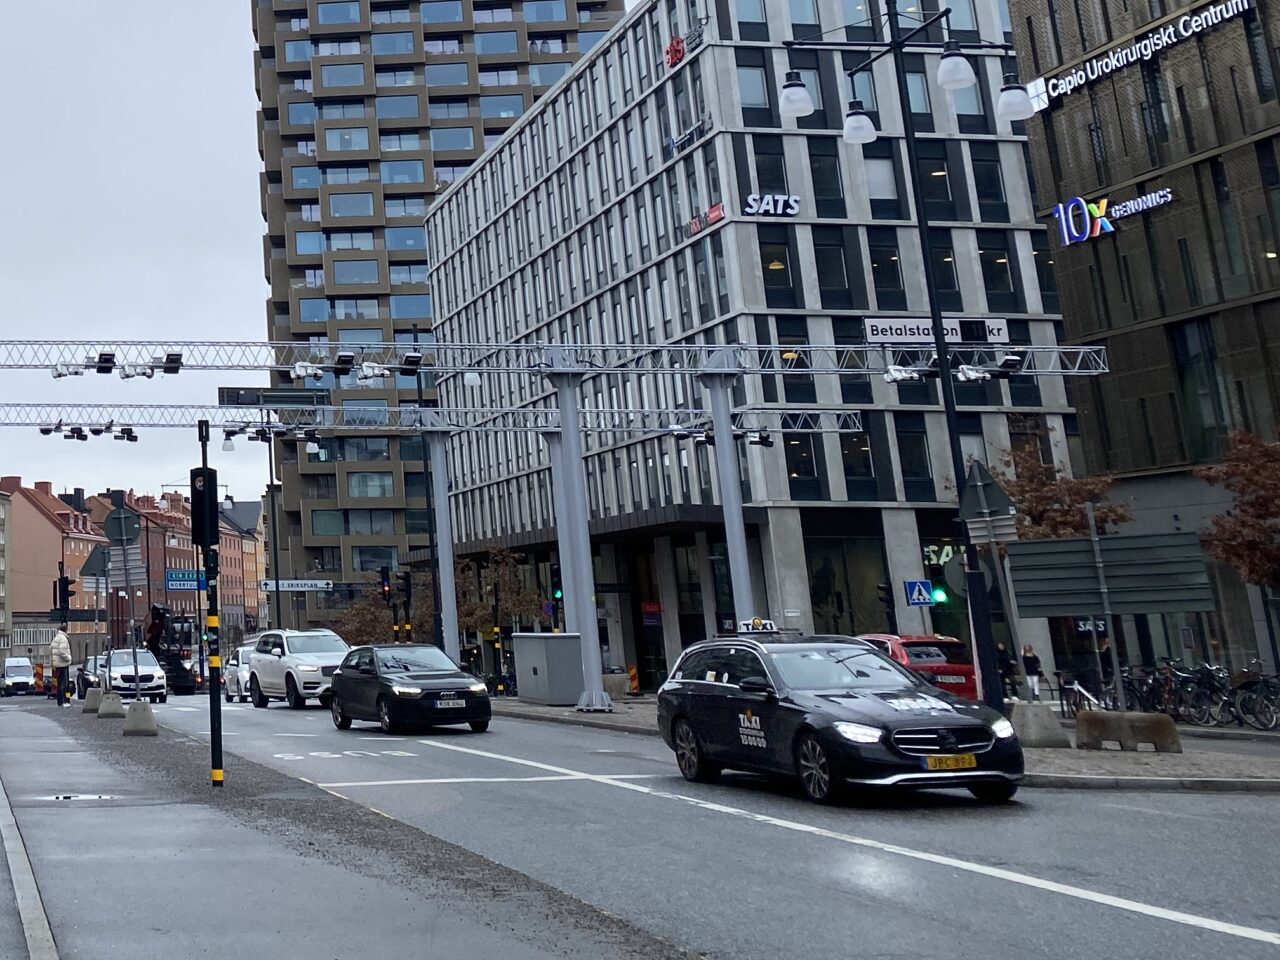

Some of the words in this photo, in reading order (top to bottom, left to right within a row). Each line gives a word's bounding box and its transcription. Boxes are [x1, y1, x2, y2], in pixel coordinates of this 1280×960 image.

[1048, 68, 1086, 97] Capio
[1086, 25, 1178, 81] Urokirurgiskt
[744, 193, 801, 215] SATS
[870, 324, 959, 337] Betalstaon
[986, 325, 1003, 337] kr
[742, 622, 774, 632] TAXI
[1077, 621, 1106, 632] SAS
